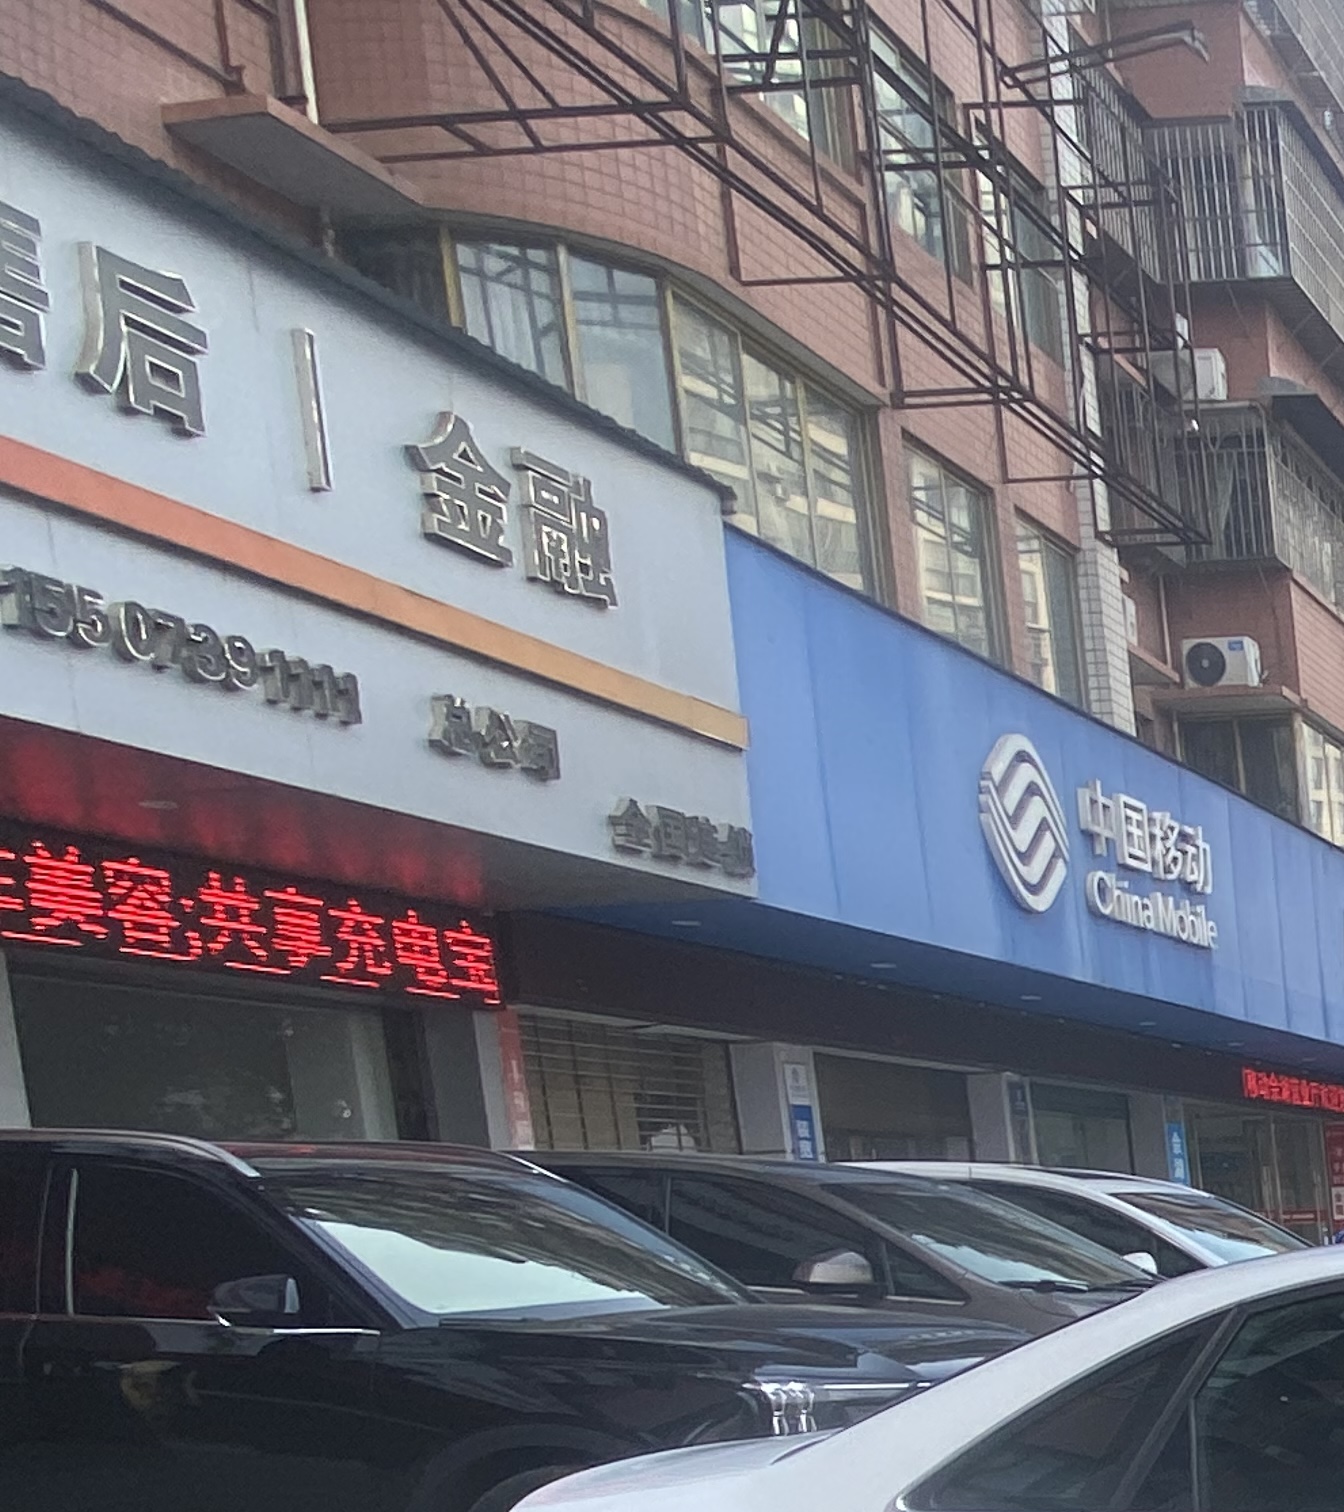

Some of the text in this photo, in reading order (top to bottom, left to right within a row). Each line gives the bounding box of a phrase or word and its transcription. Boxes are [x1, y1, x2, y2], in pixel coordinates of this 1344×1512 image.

[405, 411, 618, 609] 金融
[1076, 778, 1212, 894] 中国移动
[1086, 870, 1219, 948] China Mobile
